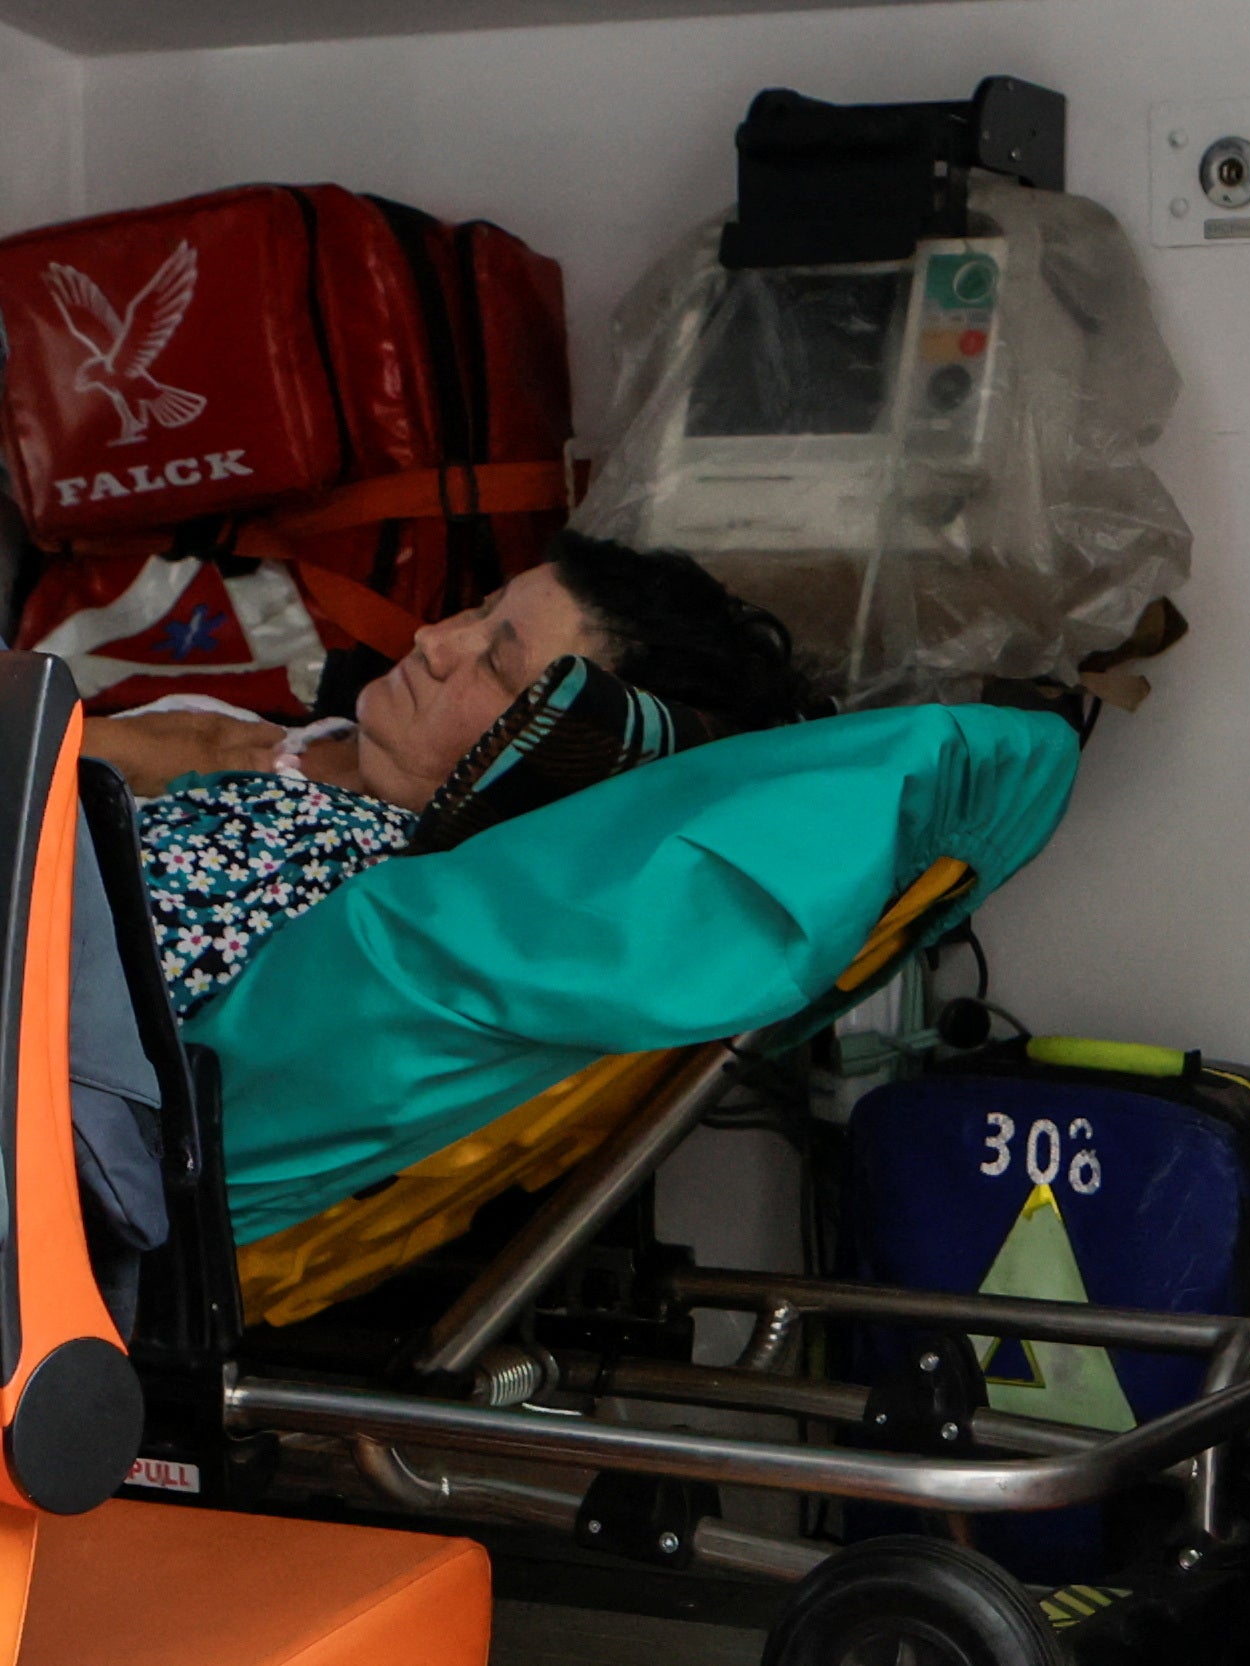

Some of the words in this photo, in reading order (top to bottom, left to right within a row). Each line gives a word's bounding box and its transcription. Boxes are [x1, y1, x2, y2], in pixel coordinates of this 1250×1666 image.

[54, 449, 254, 507] FALCK
[979, 1111, 1101, 1195] 308
[127, 1461, 192, 1487] PULL
